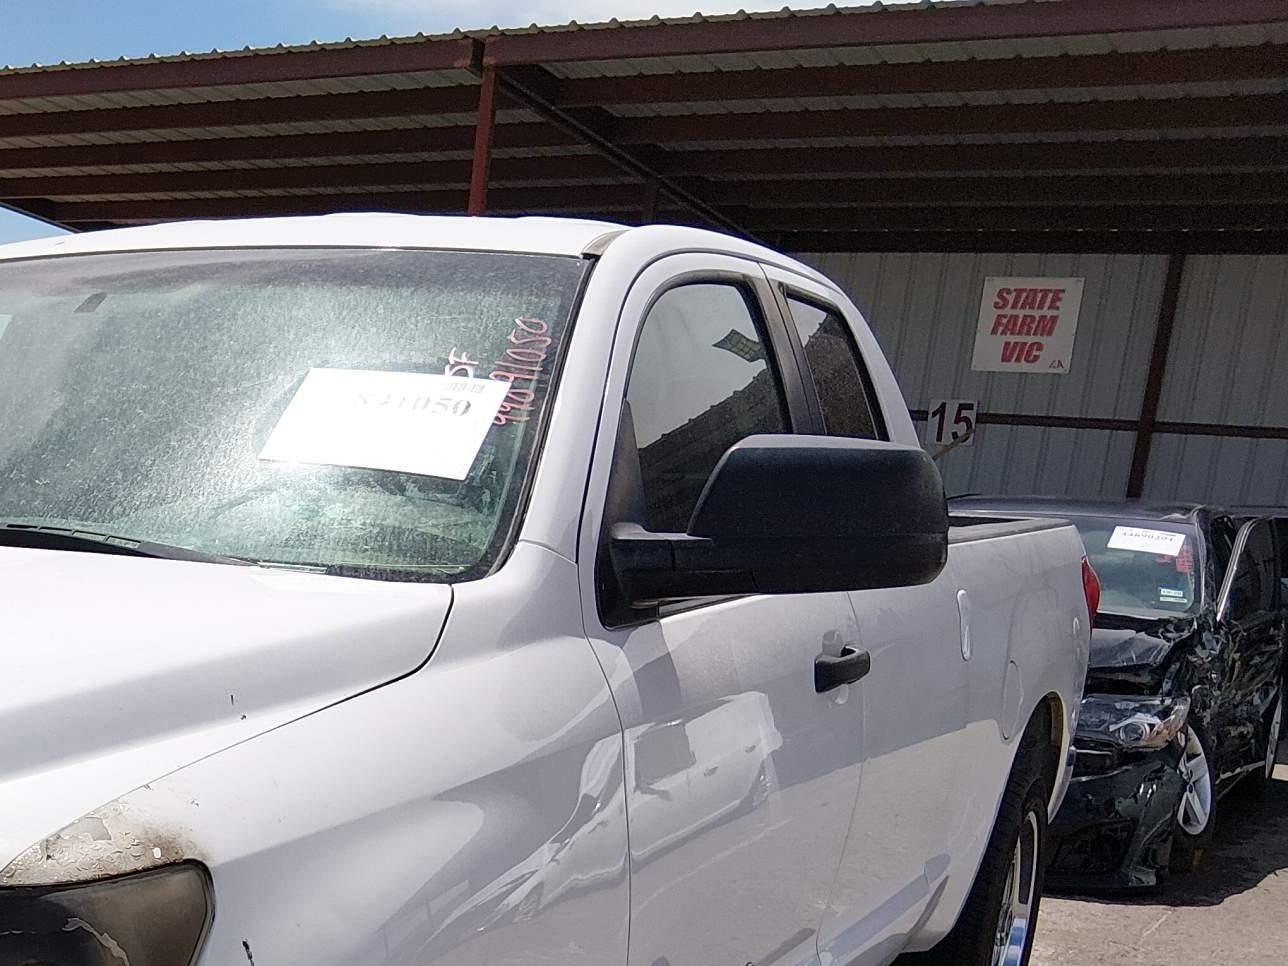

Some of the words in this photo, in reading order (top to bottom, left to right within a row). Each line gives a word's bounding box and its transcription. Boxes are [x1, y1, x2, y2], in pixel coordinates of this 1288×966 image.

[993, 287, 1066, 311] STATE
[990, 313, 1060, 337] FARM
[1000, 340, 1044, 364] VIC
[931, 401, 974, 444] 15
